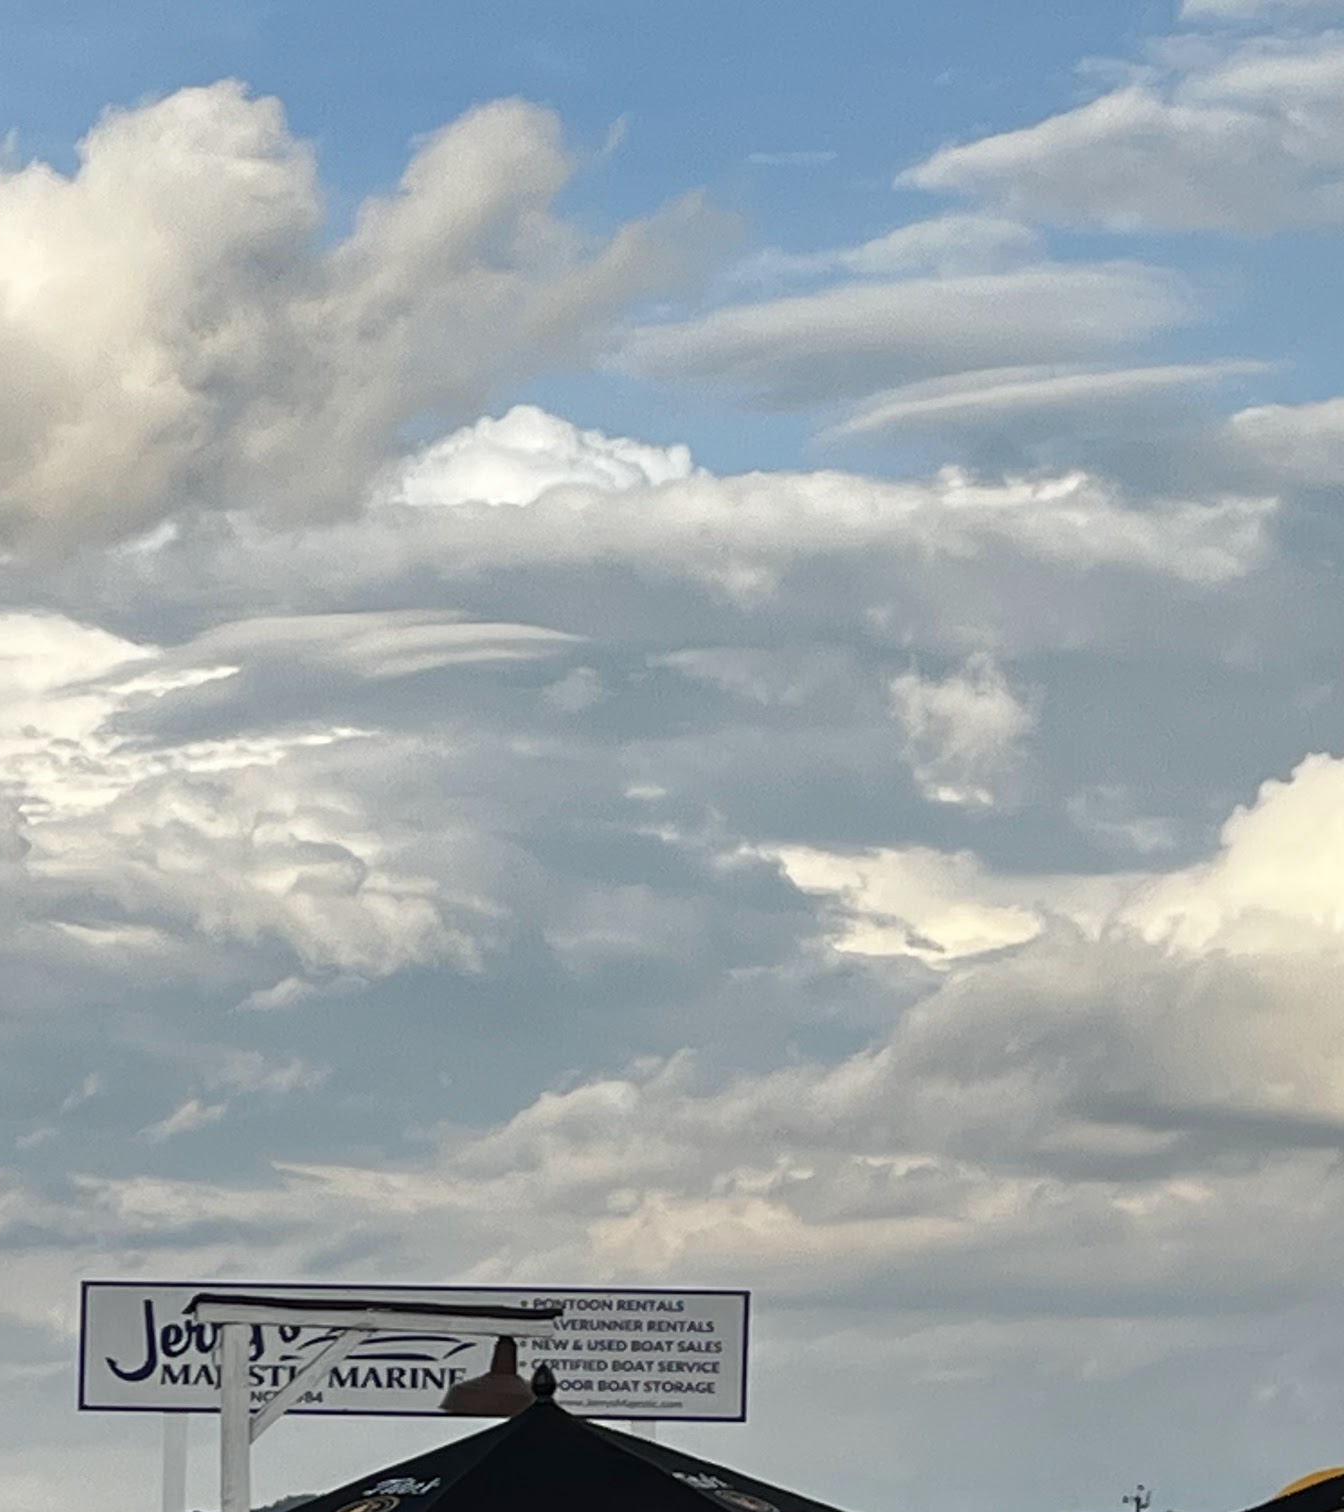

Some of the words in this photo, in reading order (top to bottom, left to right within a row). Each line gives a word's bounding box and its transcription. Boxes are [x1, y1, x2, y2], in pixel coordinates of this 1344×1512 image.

[616, 1299, 685, 1312] RENTALS
[553, 1318, 643, 1331] VERUNNER
[647, 1320, 715, 1333] RENTALS
[106, 1299, 302, 1382] Jery
[531, 1339, 569, 1350] NEW
[572, 1339, 584, 1351] &
[587, 1340, 627, 1352] USED
[630, 1341, 673, 1352] BOAT
[677, 1341, 723, 1353] SALES
[611, 1360, 654, 1373] BOAT
[658, 1361, 720, 1374] SERVICE
[598, 1380, 640, 1392] BOAT
[643, 1381, 716, 1394] STORAGE
